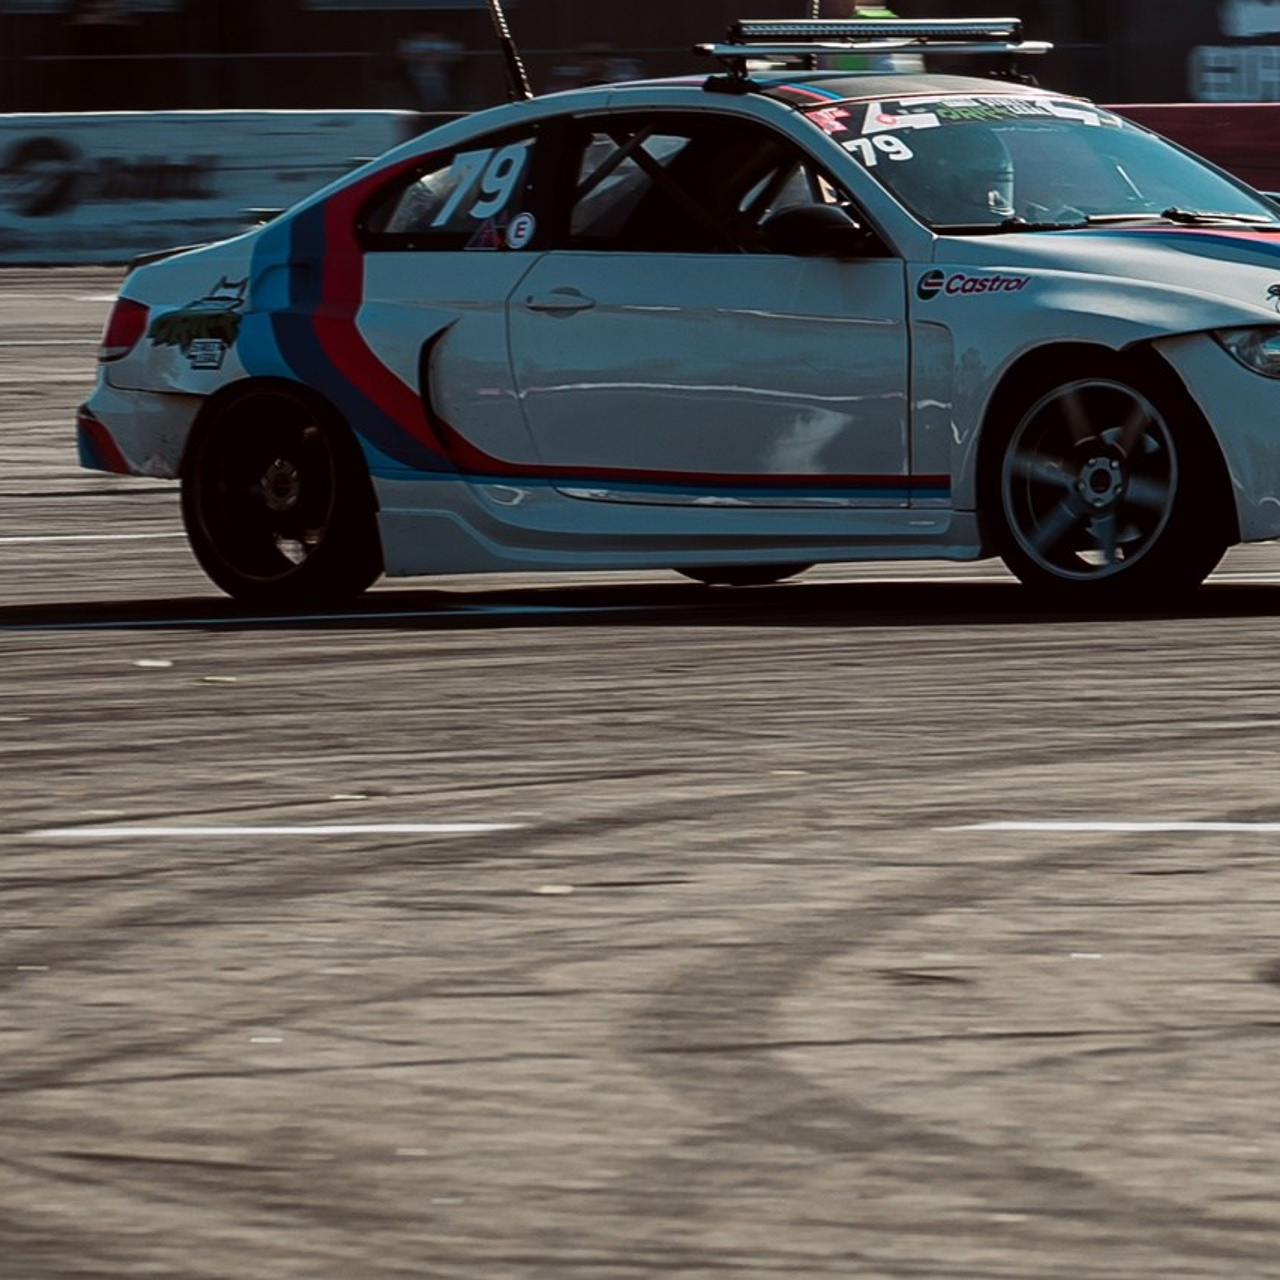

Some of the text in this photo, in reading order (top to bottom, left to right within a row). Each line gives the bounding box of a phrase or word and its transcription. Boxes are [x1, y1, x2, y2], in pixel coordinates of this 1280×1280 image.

[841, 134, 913, 167] 79
[430, 143, 527, 227] 79
[944, 273, 1032, 295] Castrol
